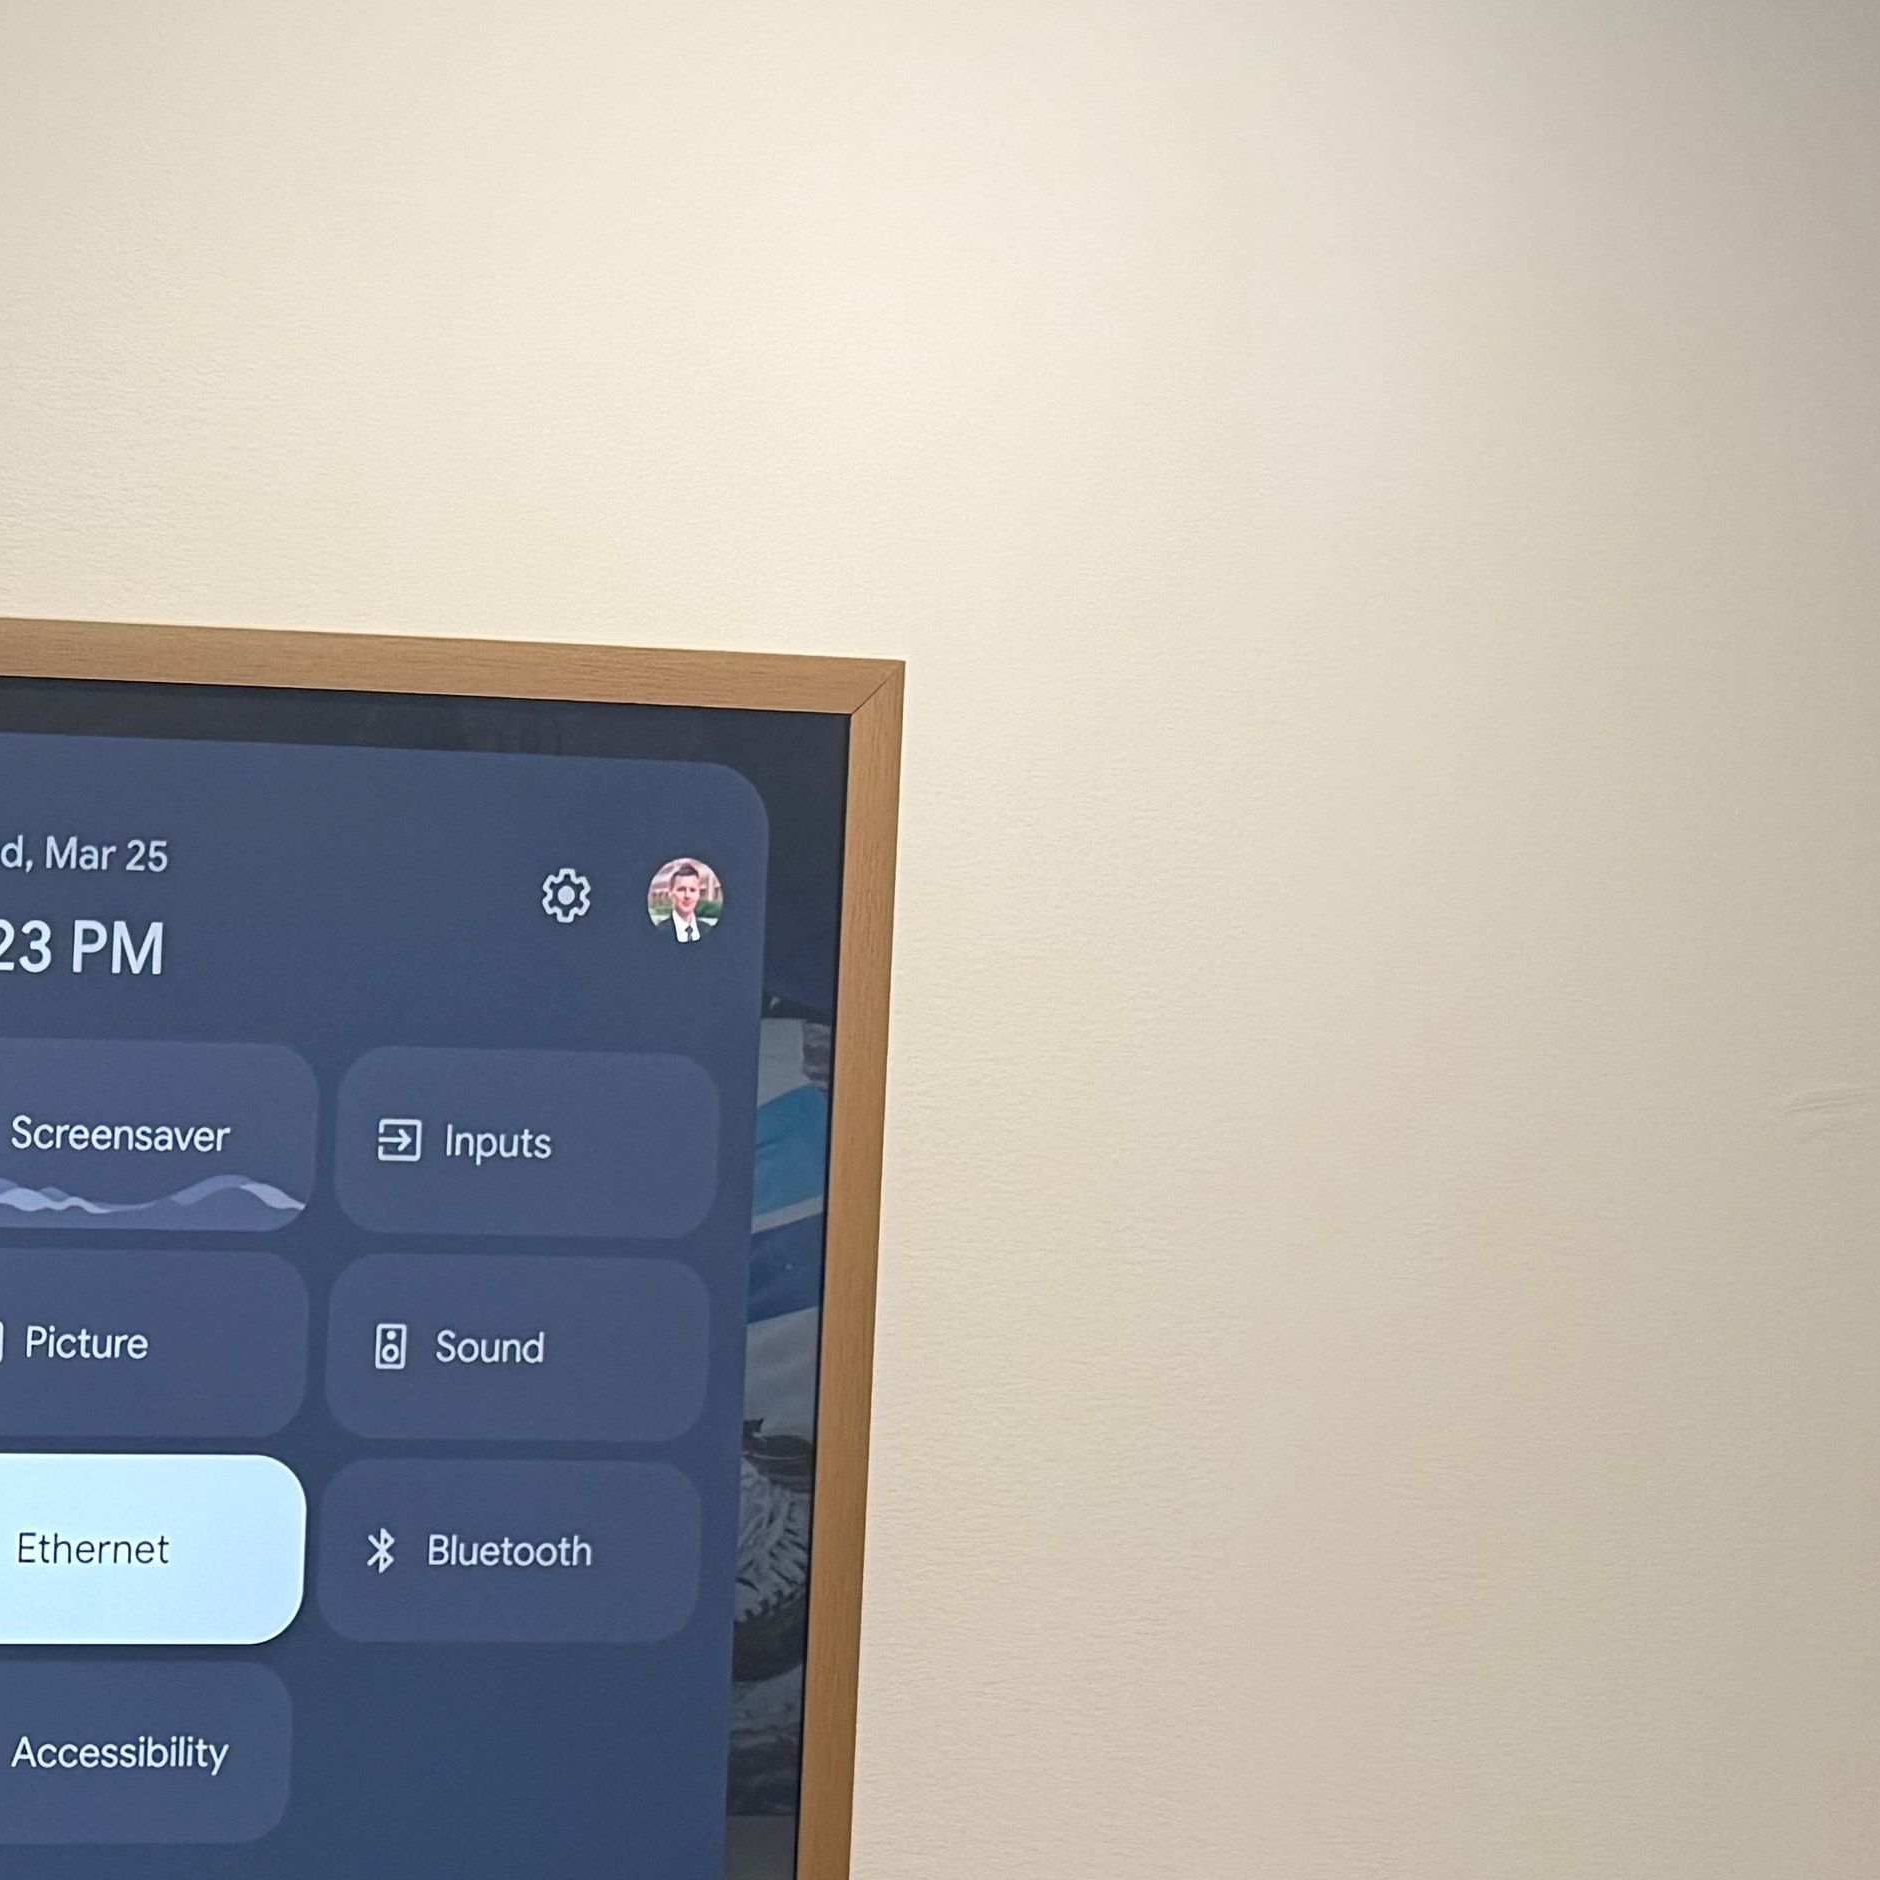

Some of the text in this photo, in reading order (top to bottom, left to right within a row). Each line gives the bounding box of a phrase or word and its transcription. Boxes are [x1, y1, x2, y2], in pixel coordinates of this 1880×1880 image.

[44, 835, 117, 871] Mar
[125, 840, 169, 873] 25
[71, 920, 165, 976] PM
[10, 1115, 231, 1154] Screensaver
[445, 1124, 552, 1165] Inputs
[25, 1326, 149, 1362] Picture
[436, 1331, 545, 1366] Sound
[17, 1532, 170, 1566] Ethernet
[427, 1533, 593, 1568] Bluetooth
[10, 1736, 230, 1777] Accessibility
